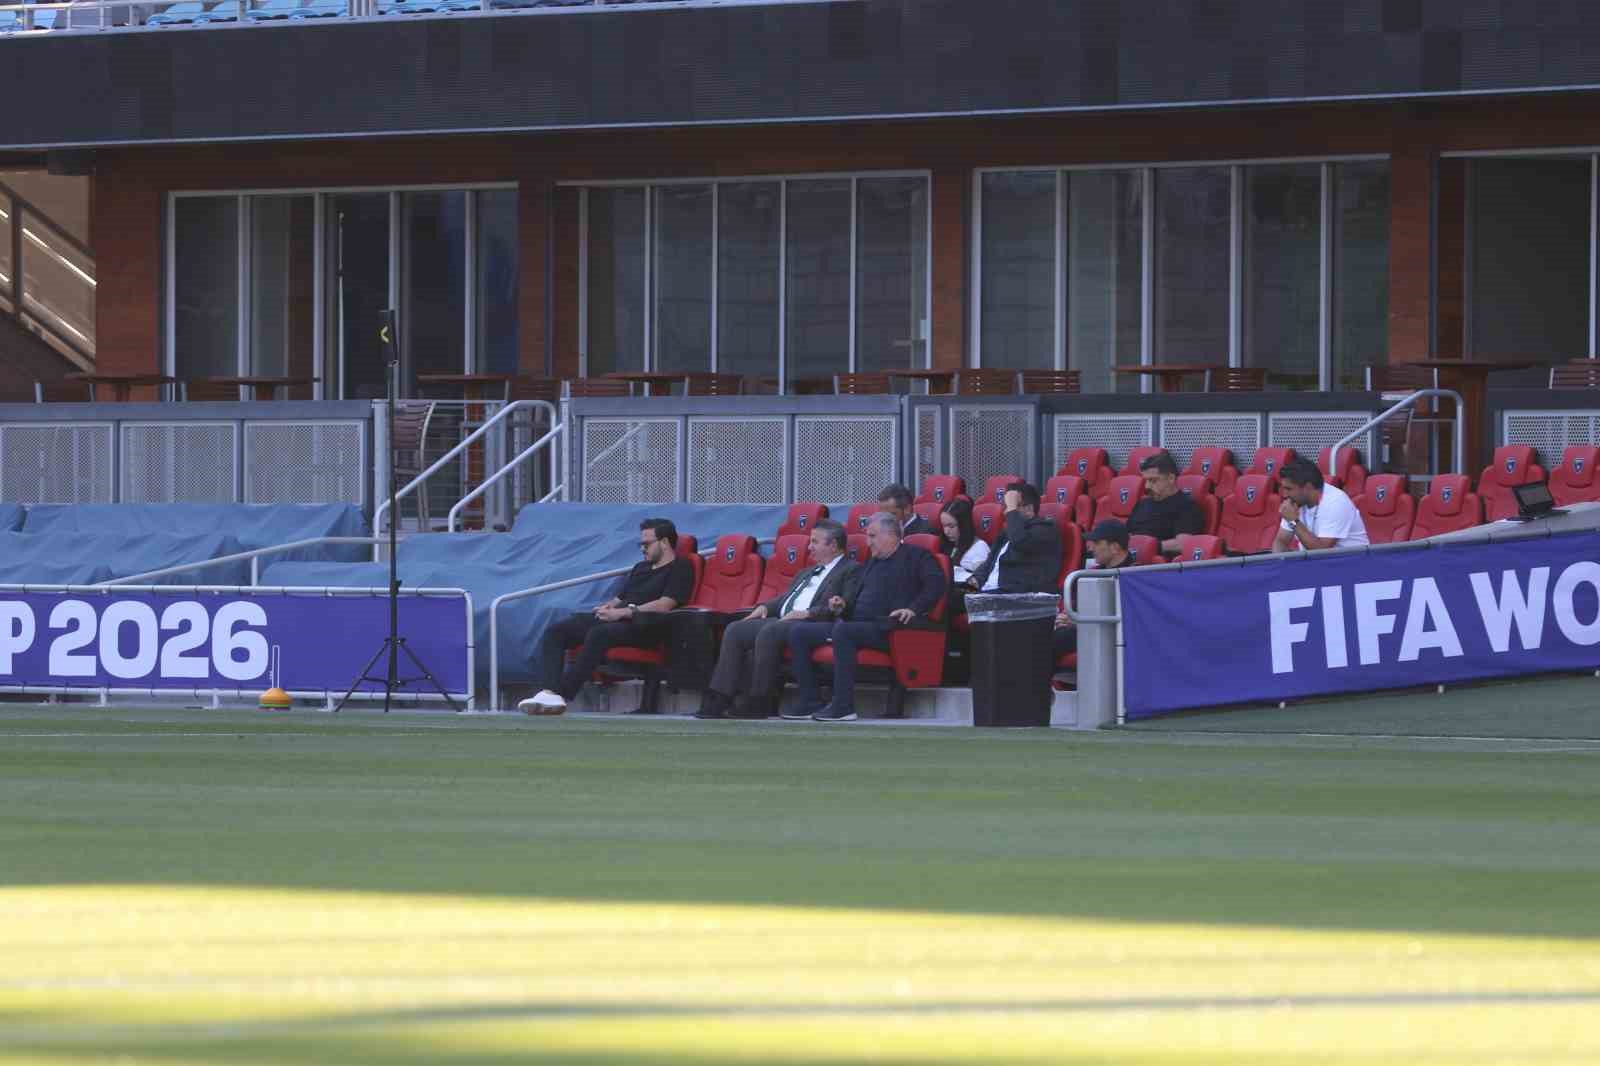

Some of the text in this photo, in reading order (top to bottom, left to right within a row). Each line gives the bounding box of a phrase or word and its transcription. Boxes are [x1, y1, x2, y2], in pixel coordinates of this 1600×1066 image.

[48, 599, 269, 681] 2026
[1268, 561, 1600, 674] FIFA WO
